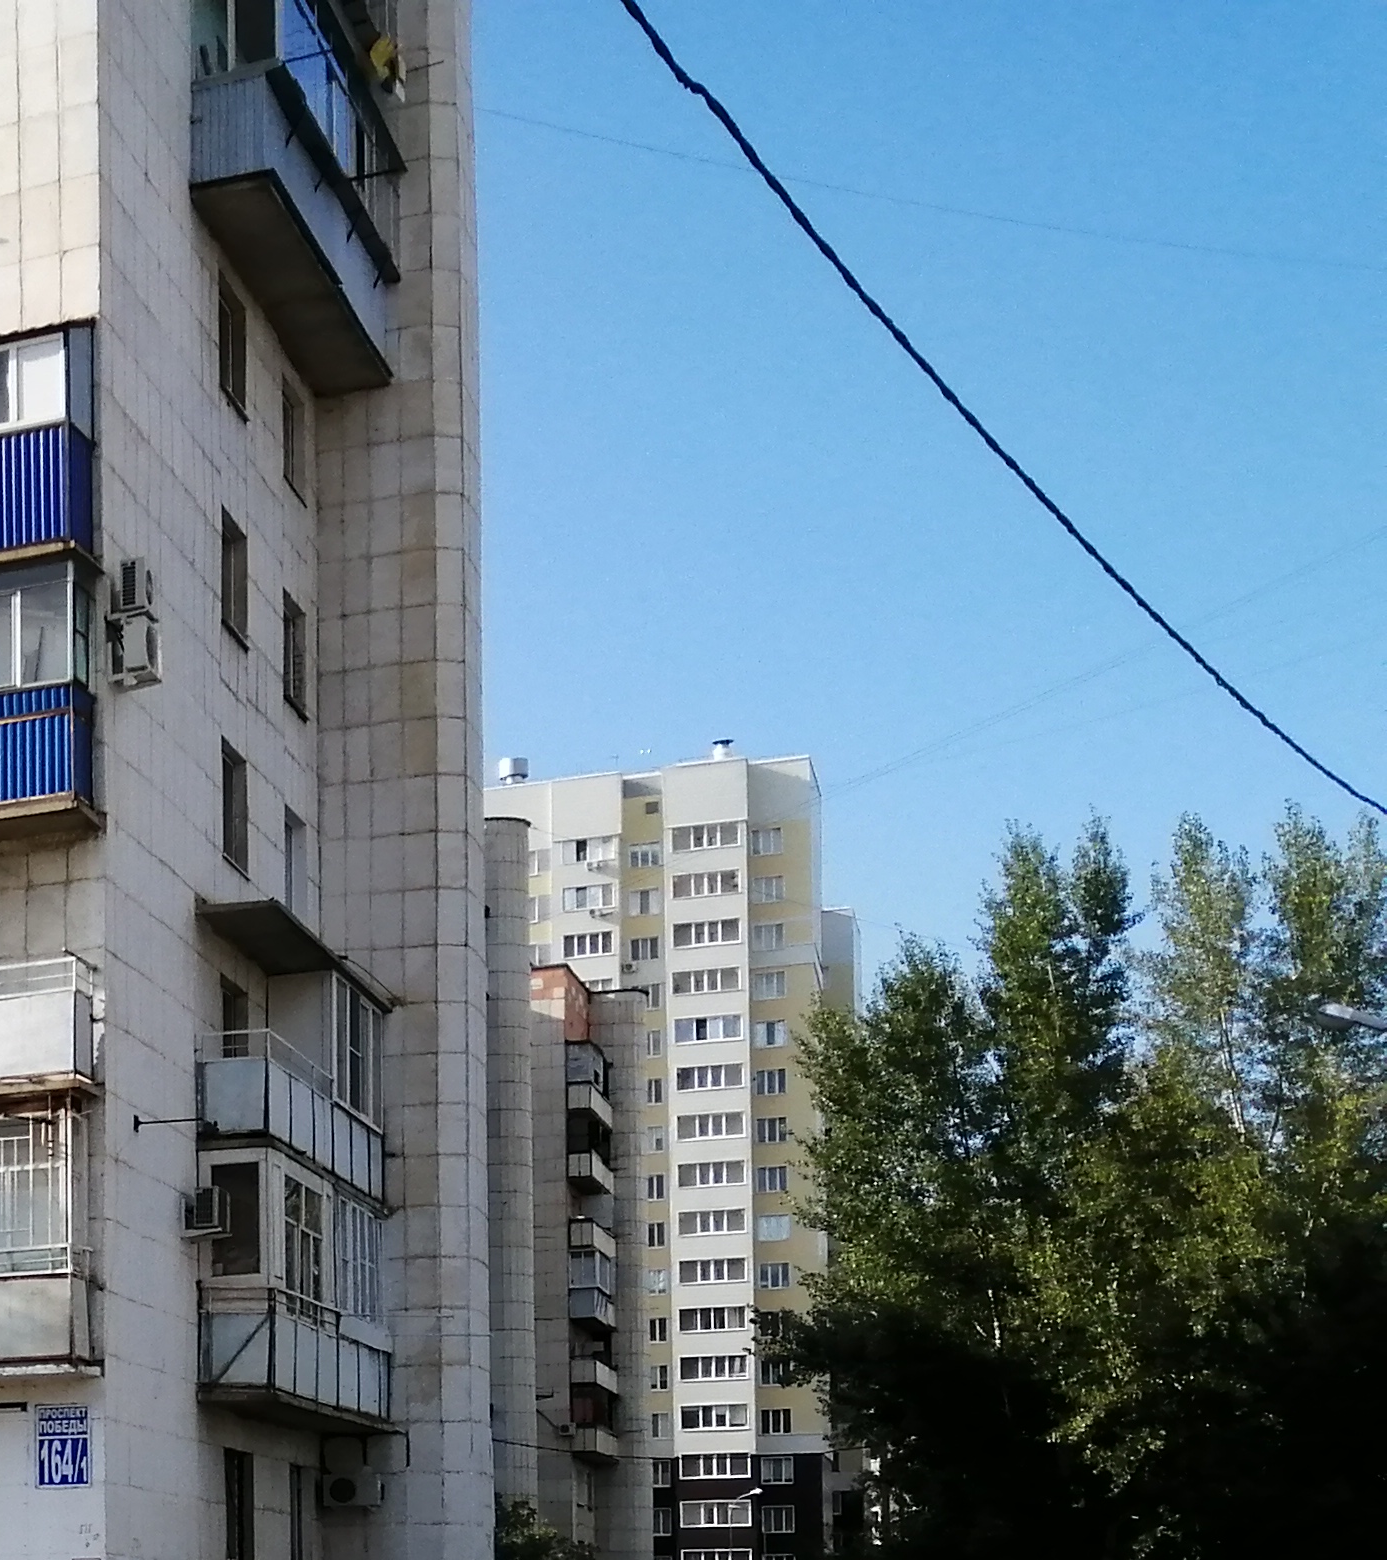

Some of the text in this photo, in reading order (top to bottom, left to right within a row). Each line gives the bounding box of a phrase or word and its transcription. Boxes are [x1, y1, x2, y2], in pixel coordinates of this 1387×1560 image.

[38, 1407, 87, 1419] ПРОСПЕКТ
[39, 1419, 88, 1435] ПОБЕДЫ
[40, 1438, 88, 1484] 164/1
